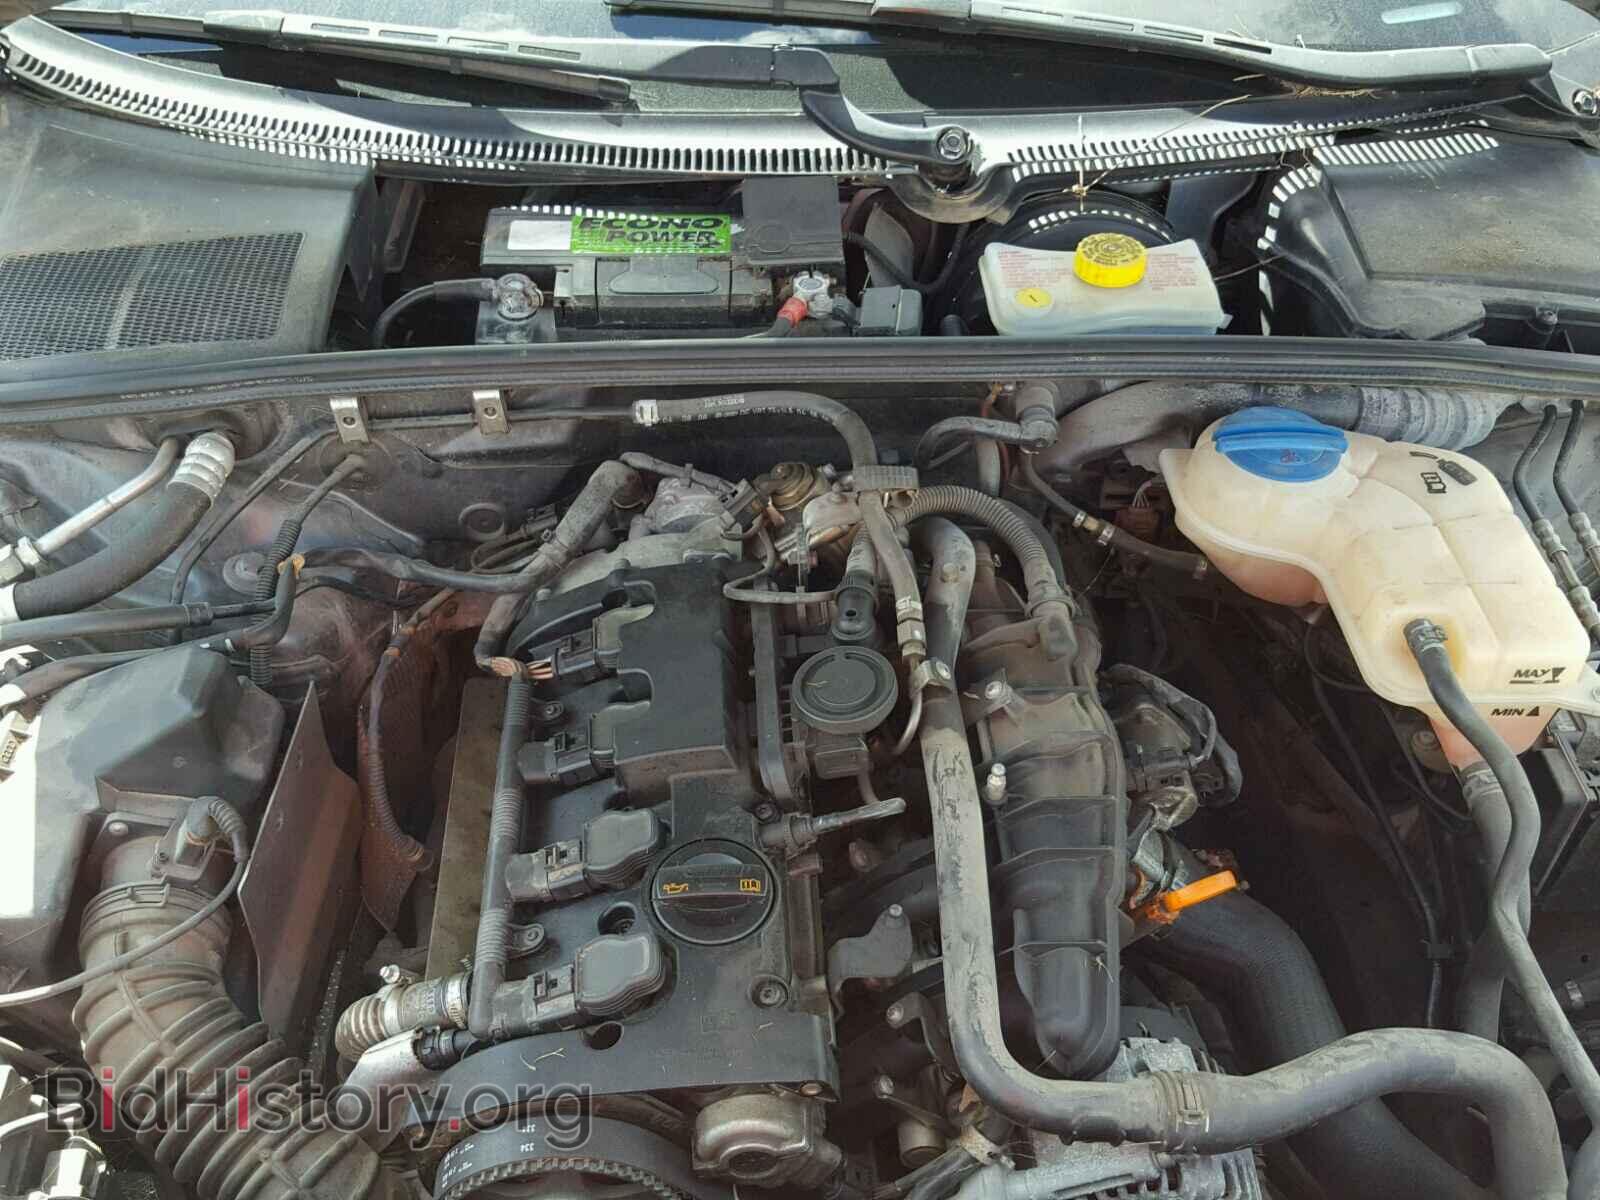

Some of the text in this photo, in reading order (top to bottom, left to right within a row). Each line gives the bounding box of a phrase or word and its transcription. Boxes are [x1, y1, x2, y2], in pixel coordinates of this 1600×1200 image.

[579, 216, 724, 230] ECONO
[605, 230, 718, 244] POWER
[1491, 708, 1525, 716] MIN
